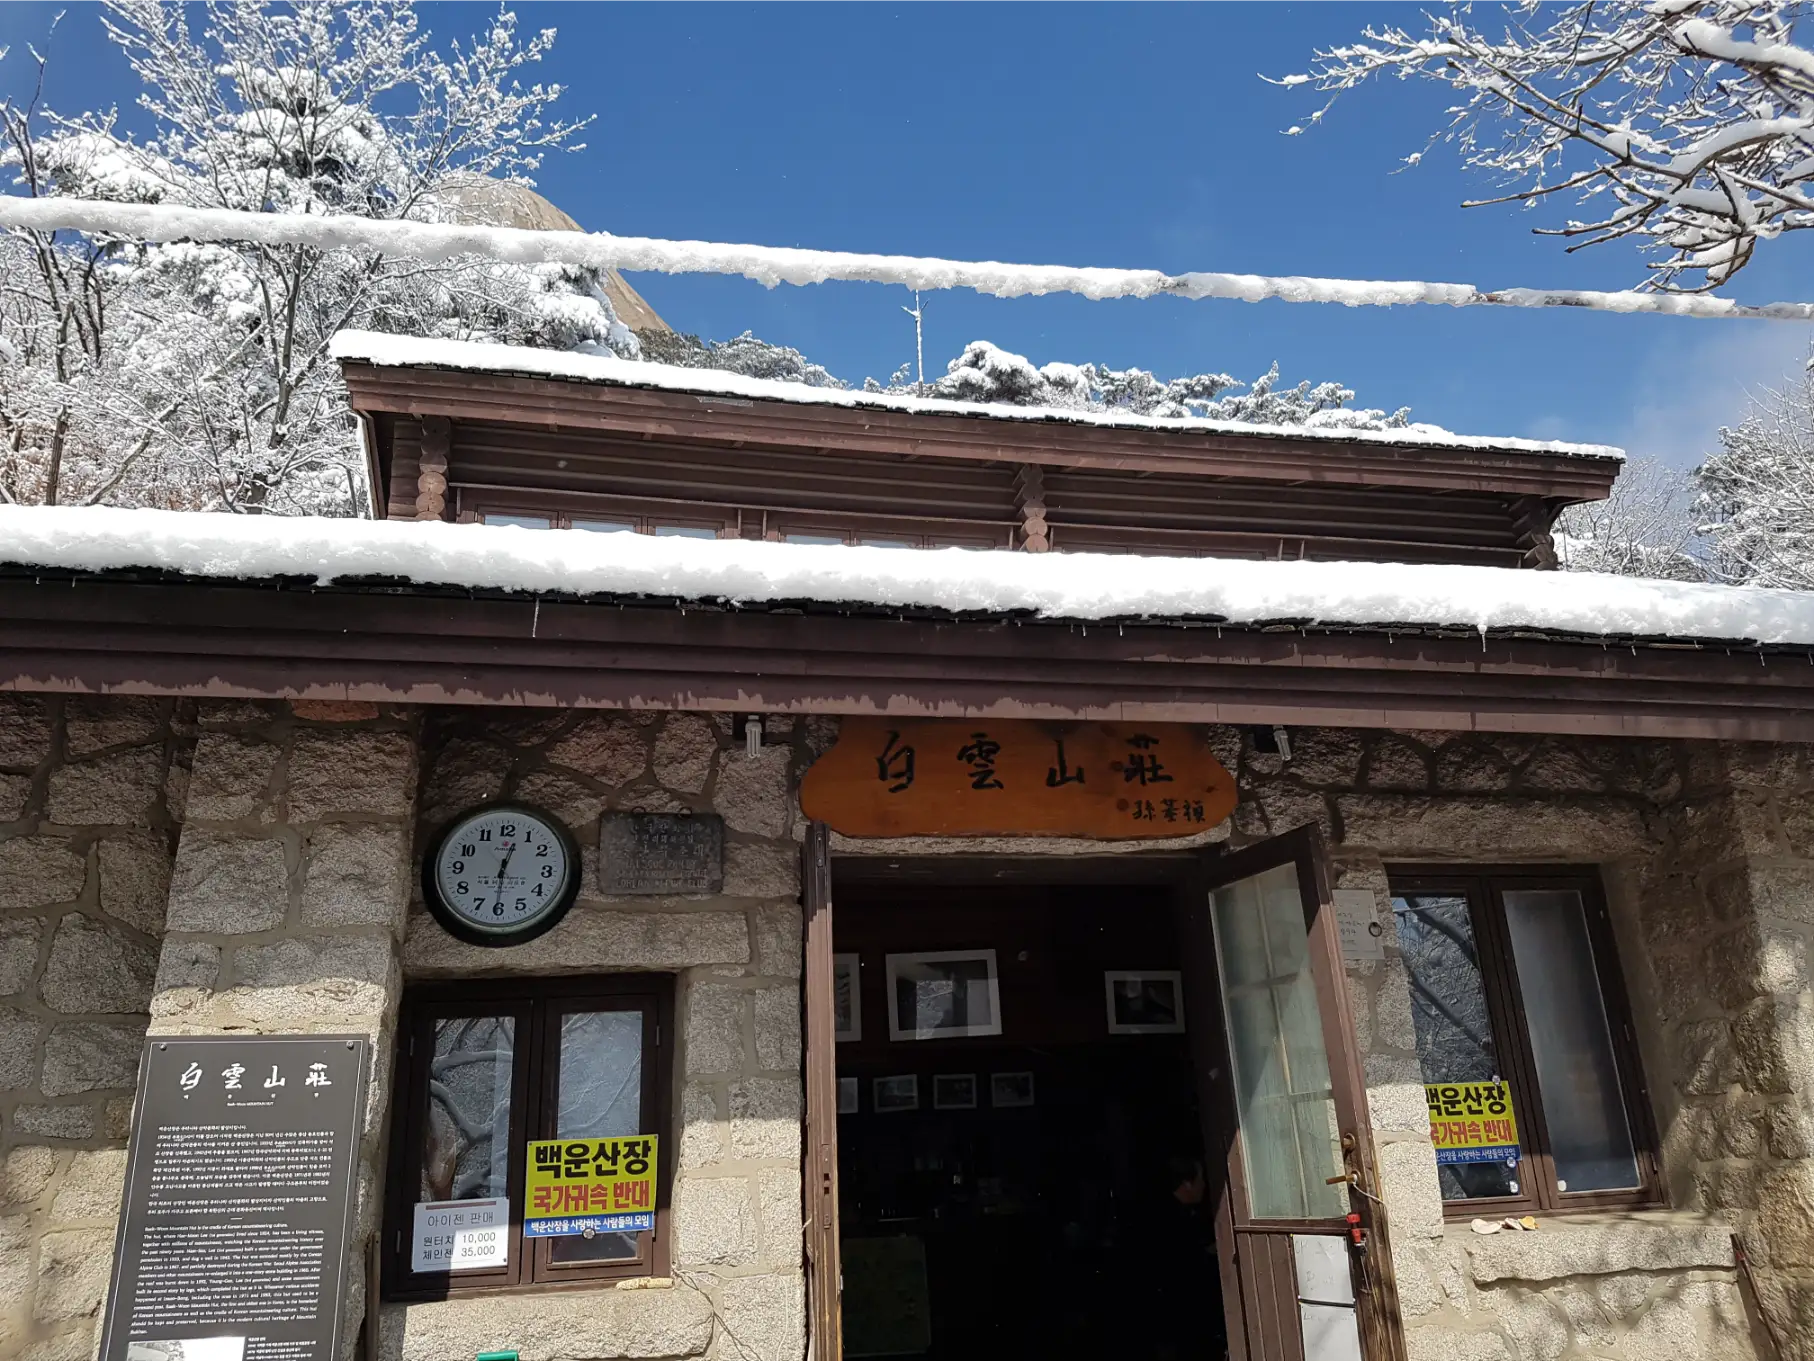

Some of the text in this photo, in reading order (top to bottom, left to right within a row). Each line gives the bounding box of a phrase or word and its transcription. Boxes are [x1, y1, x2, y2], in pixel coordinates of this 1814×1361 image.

[479, 829, 492, 842] 11
[500, 824, 516, 837] 12
[524, 830, 532, 842] 1
[462, 844, 476, 856] 10
[536, 844, 548, 857] 2
[452, 861, 464, 874] 9
[540, 865, 552, 878] 3
[456, 881, 469, 894] 8
[531, 883, 544, 896] 4
[473, 898, 486, 910] 7
[492, 902, 504, 916] 6
[515, 898, 526, 910] 5
[180, 1061, 333, 1091] 白雲山莊
[1483, 1119, 1513, 1143] 반대
[535, 1140, 652, 1179] 백운산장
[1458, 1149, 1481, 1160] 사랑하는
[1481, 1148, 1504, 1159] 사람들의
[1504, 1147, 1516, 1157] 모임
[533, 1180, 649, 1213] 국가귀속 반대
[427, 1211, 494, 1228] 아이젠 판매
[530, 1214, 649, 1234] 백운산장을 사랑하는 사람들의 모임
[462, 1232, 496, 1244] 10,000
[460, 1245, 496, 1257] 35,000
